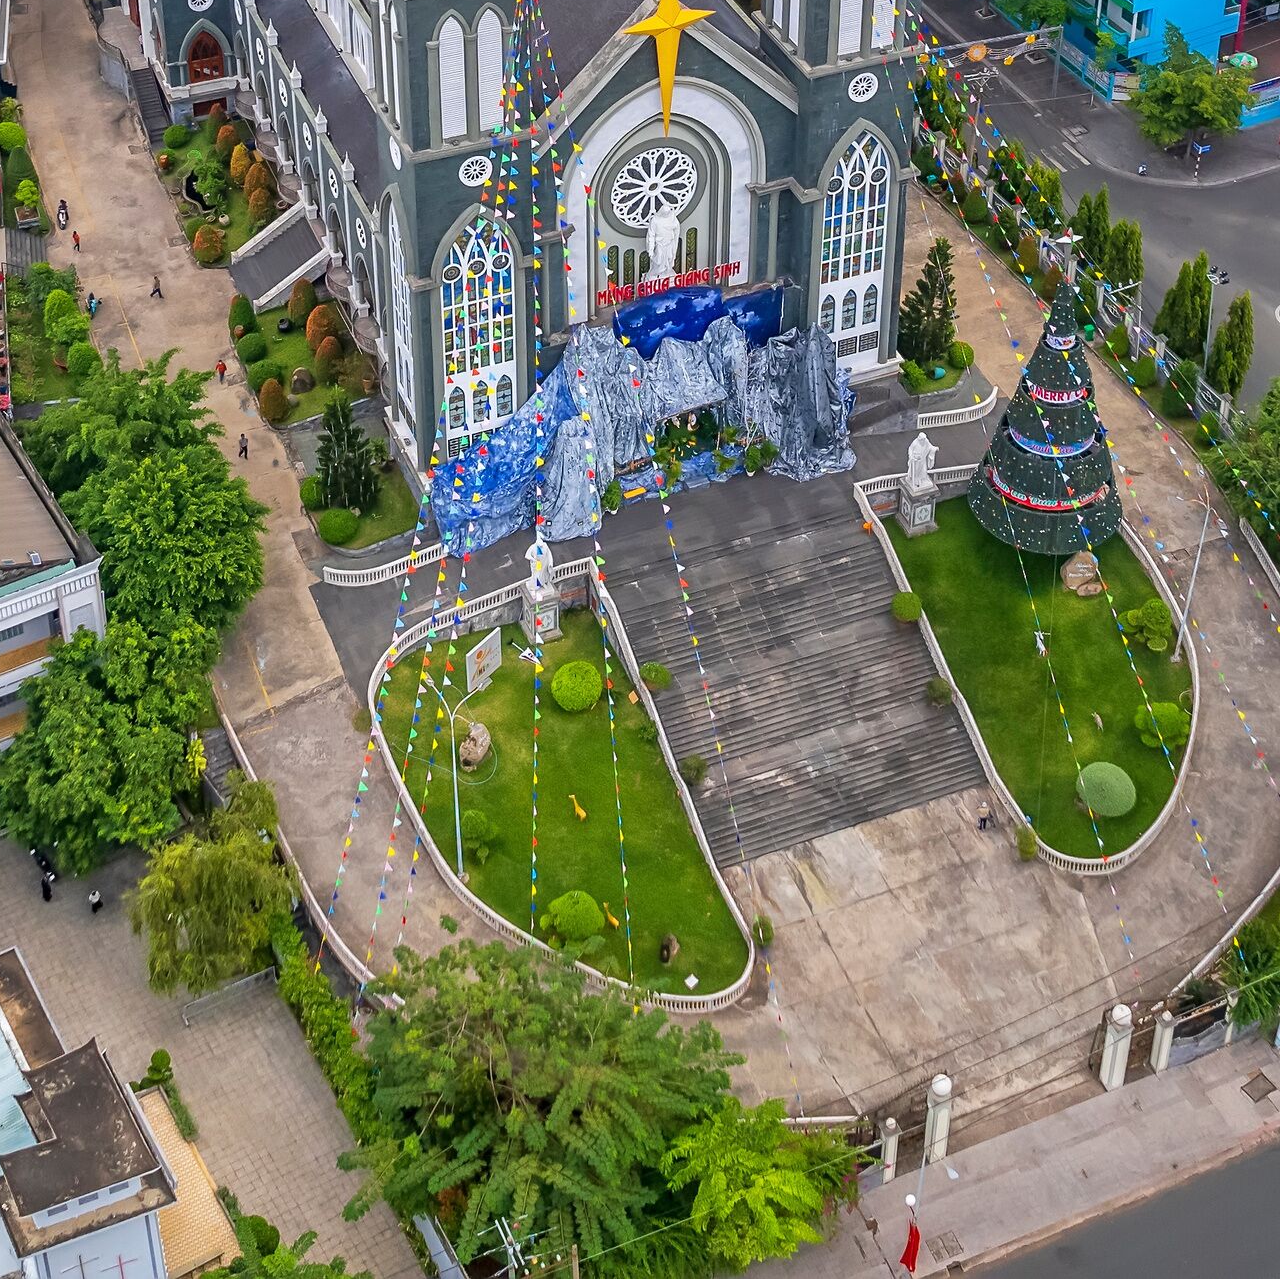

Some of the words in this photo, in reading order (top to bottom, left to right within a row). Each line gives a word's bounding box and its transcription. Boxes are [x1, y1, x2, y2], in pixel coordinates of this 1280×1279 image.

[637, 275, 670, 297] CHÚA
[674, 267, 710, 288] GIÁNG
[714, 261, 741, 280] SINH
[1035, 387, 1071, 402] MERRY
